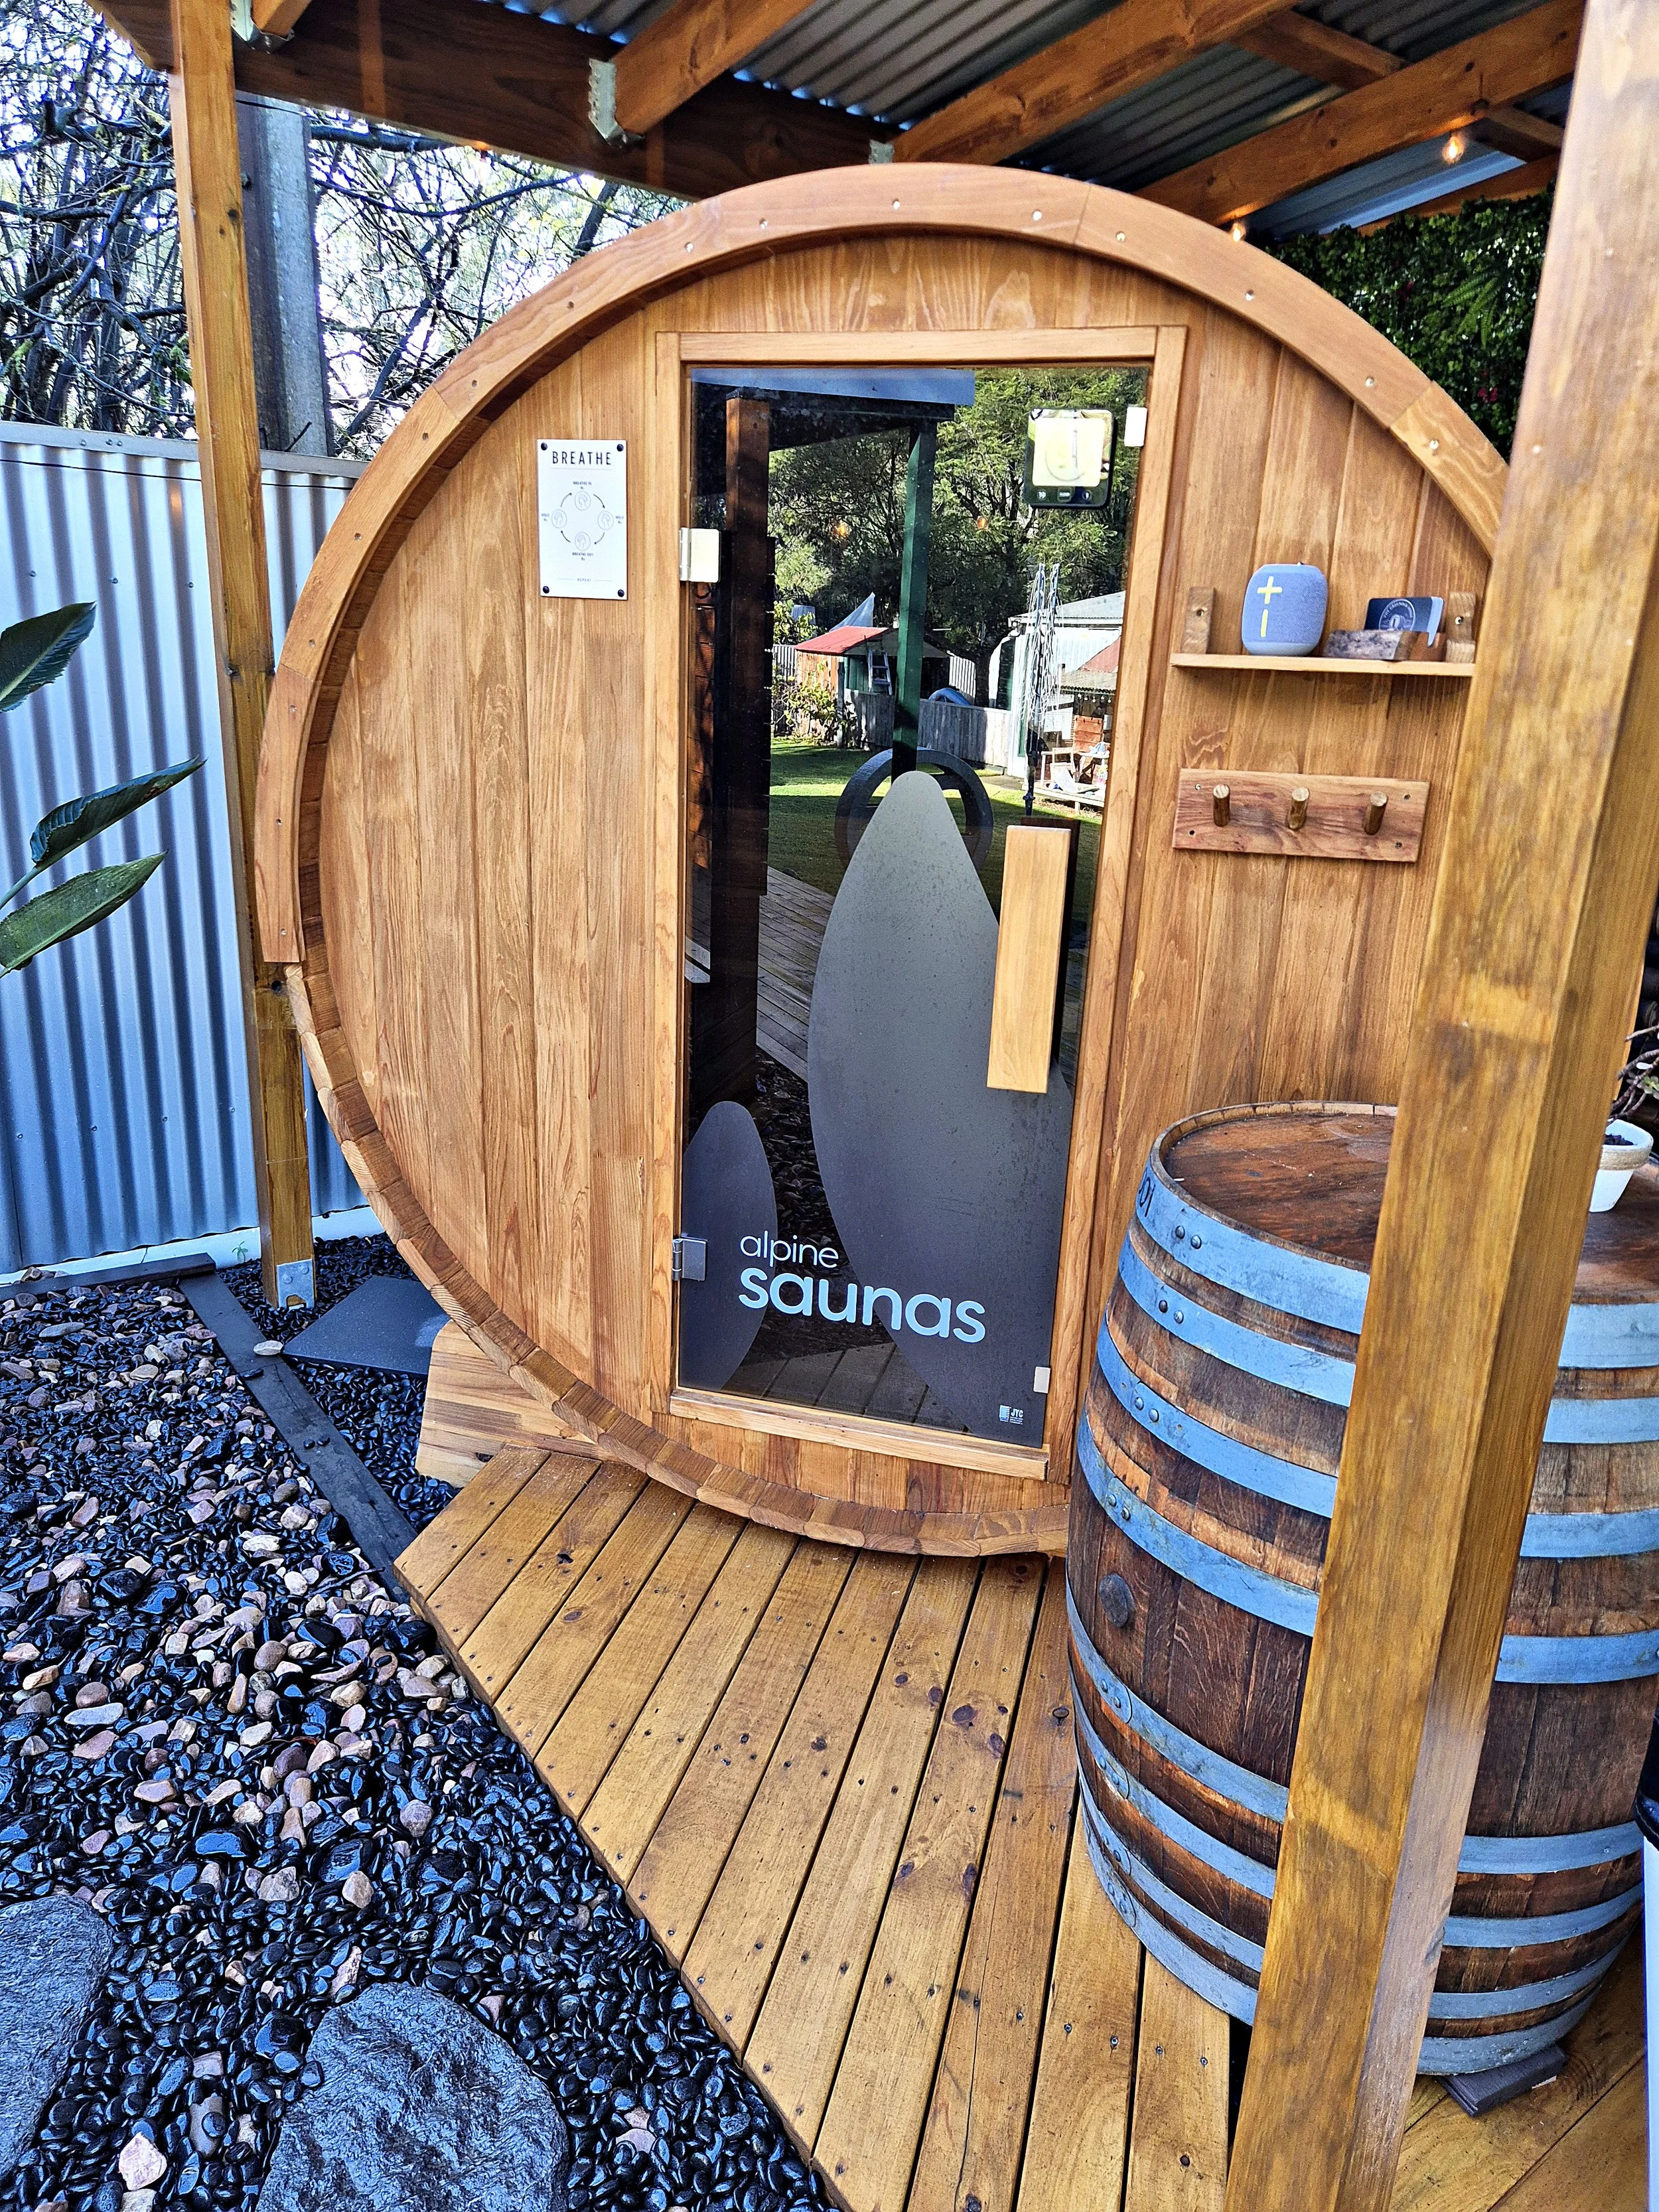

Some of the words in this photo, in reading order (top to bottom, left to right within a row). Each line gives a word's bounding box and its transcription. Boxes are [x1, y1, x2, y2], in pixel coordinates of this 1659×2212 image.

[552, 451, 611, 465] BREATHE
[740, 1230, 839, 1268] alpine
[738, 1268, 985, 1343] saunas
[1011, 1408, 1023, 1418] JYC
